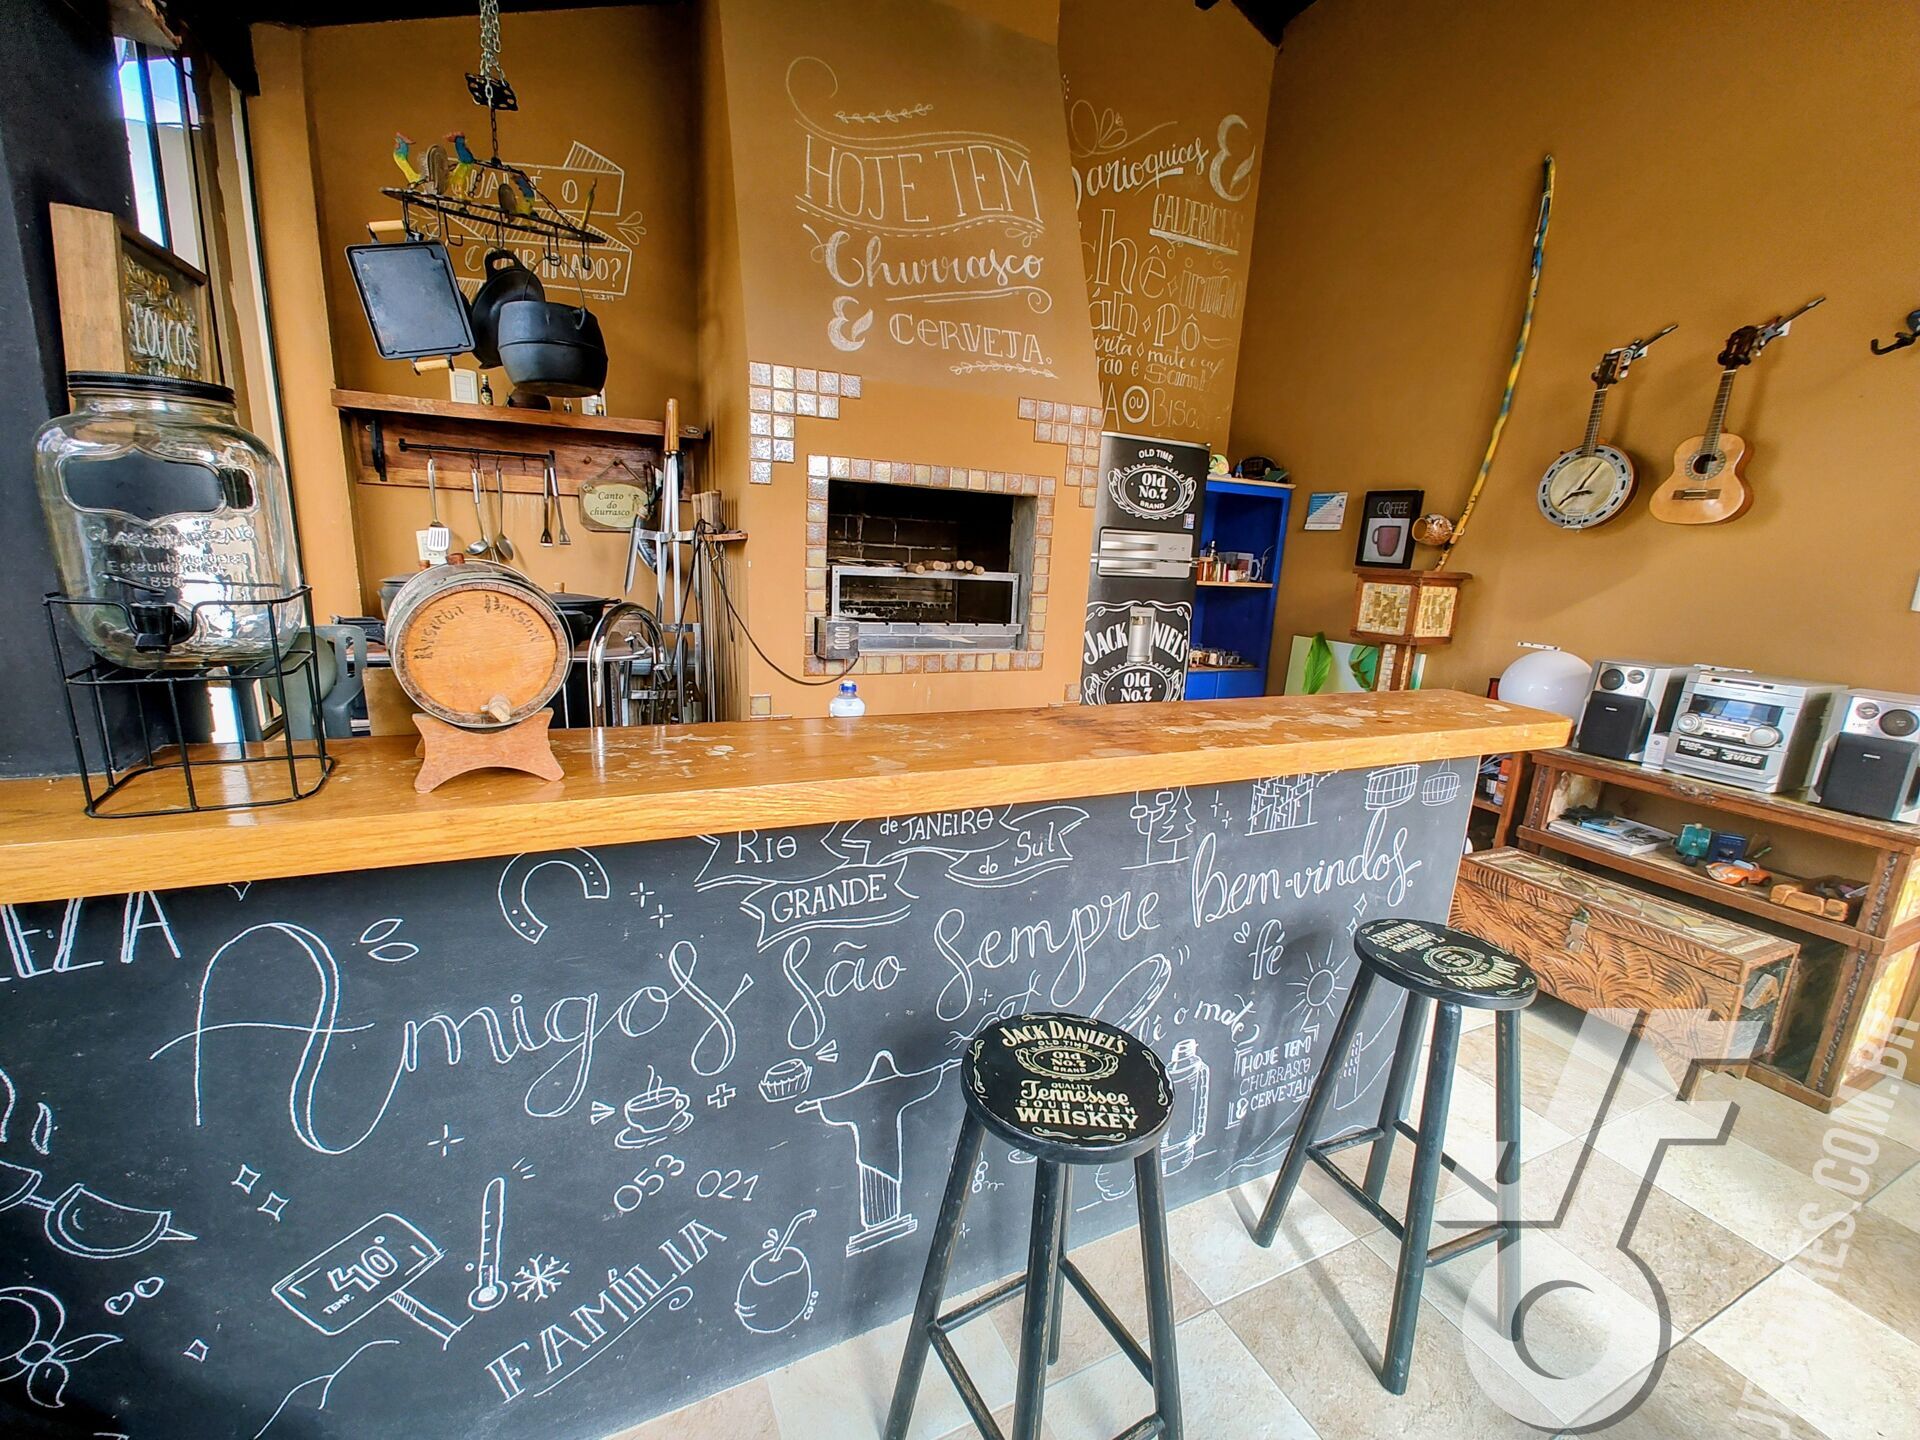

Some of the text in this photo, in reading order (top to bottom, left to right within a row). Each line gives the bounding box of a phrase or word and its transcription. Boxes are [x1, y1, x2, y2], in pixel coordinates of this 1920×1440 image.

[1209, 113, 1256, 202] &
[562, 179, 578, 204] O
[803, 134, 1044, 224] HOJE TEM
[805, 226, 1044, 289] Churrasco
[828, 295, 874, 352] &
[1138, 448, 1175, 463] OLD TIME
[1141, 472, 1167, 488] Old
[597, 491, 624, 501] Canto
[606, 500, 618, 509] do
[1138, 485, 1168, 501] No.7
[1139, 500, 1165, 509] BRAND
[589, 505, 631, 517] churrasco
[1376, 501, 1409, 516] COFFEE
[1083, 620, 1189, 665] JACK NIEL'S
[1123, 672, 1151, 688] Old
[1120, 686, 1154, 702] No.7
[879, 807, 995, 845] de JANEIRO
[735, 829, 797, 864] RIO
[978, 821, 1056, 876] do Sul
[771, 873, 888, 923] GRANDE
[1248, 918, 1286, 980] fé
[149, 921, 754, 1155] Amigos
[782, 934, 907, 1051] São
[933, 890, 1161, 1022] Sempre
[999, 1020, 1128, 1055] JACK DANIEL'S
[1063, 1040, 1089, 1049] TIME
[1050, 1058, 1087, 1068] No.7
[1052, 1050, 1082, 1060] Old
[1240, 1046, 1280, 1077] HOJE
[1052, 1065, 1087, 1074] BRAND
[1239, 1057, 1312, 1096] CHURRASCO
[1020, 1079, 1130, 1106] Tennessee
[1050, 1082, 1093, 1092] QUALITY
[1014, 1107, 1140, 1130] WHISKEY
[1019, 1099, 1137, 1115] SOUR MASH
[613, 1154, 760, 1213] 053 021
[483, 1218, 728, 1405] FAMÍLIA
